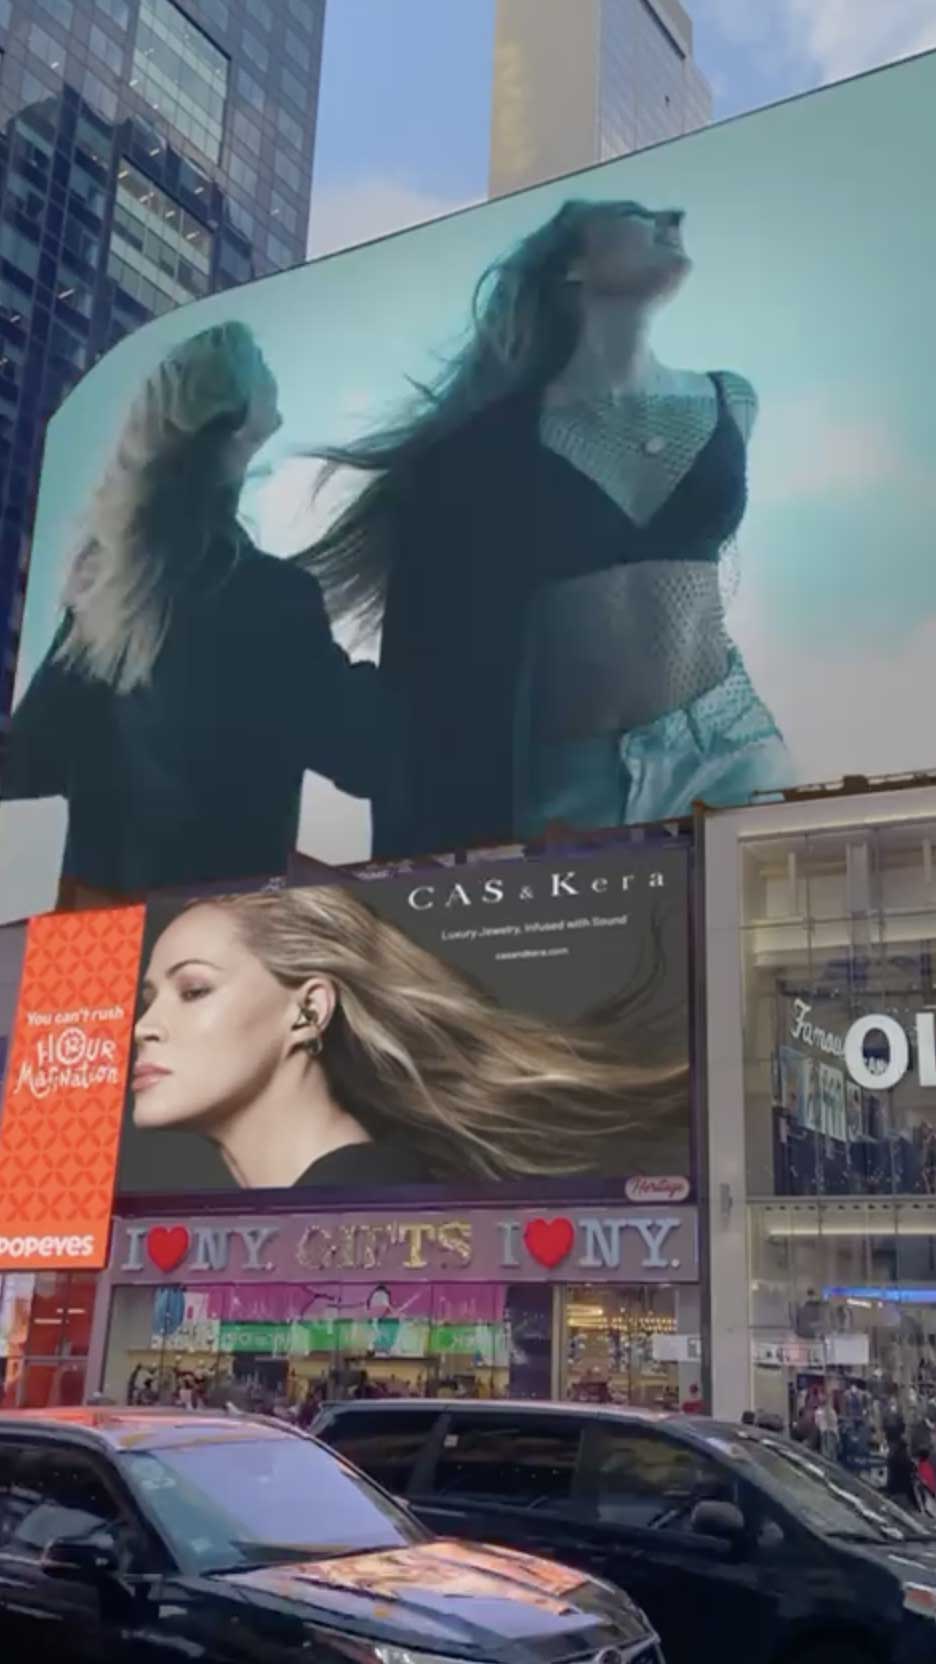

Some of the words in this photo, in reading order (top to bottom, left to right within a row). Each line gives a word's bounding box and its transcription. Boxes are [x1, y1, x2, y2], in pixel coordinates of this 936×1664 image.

[408, 878, 504, 911] CAS
[519, 885, 534, 900] &
[551, 871, 665, 898] Kera
[567, 917, 590, 928] with
[28, 1012, 52, 1026] You
[54, 1007, 89, 1025] can't
[91, 1005, 125, 1022] rush
[790, 997, 846, 1056] Famou
[296, 1220, 472, 1271] GIFTS
